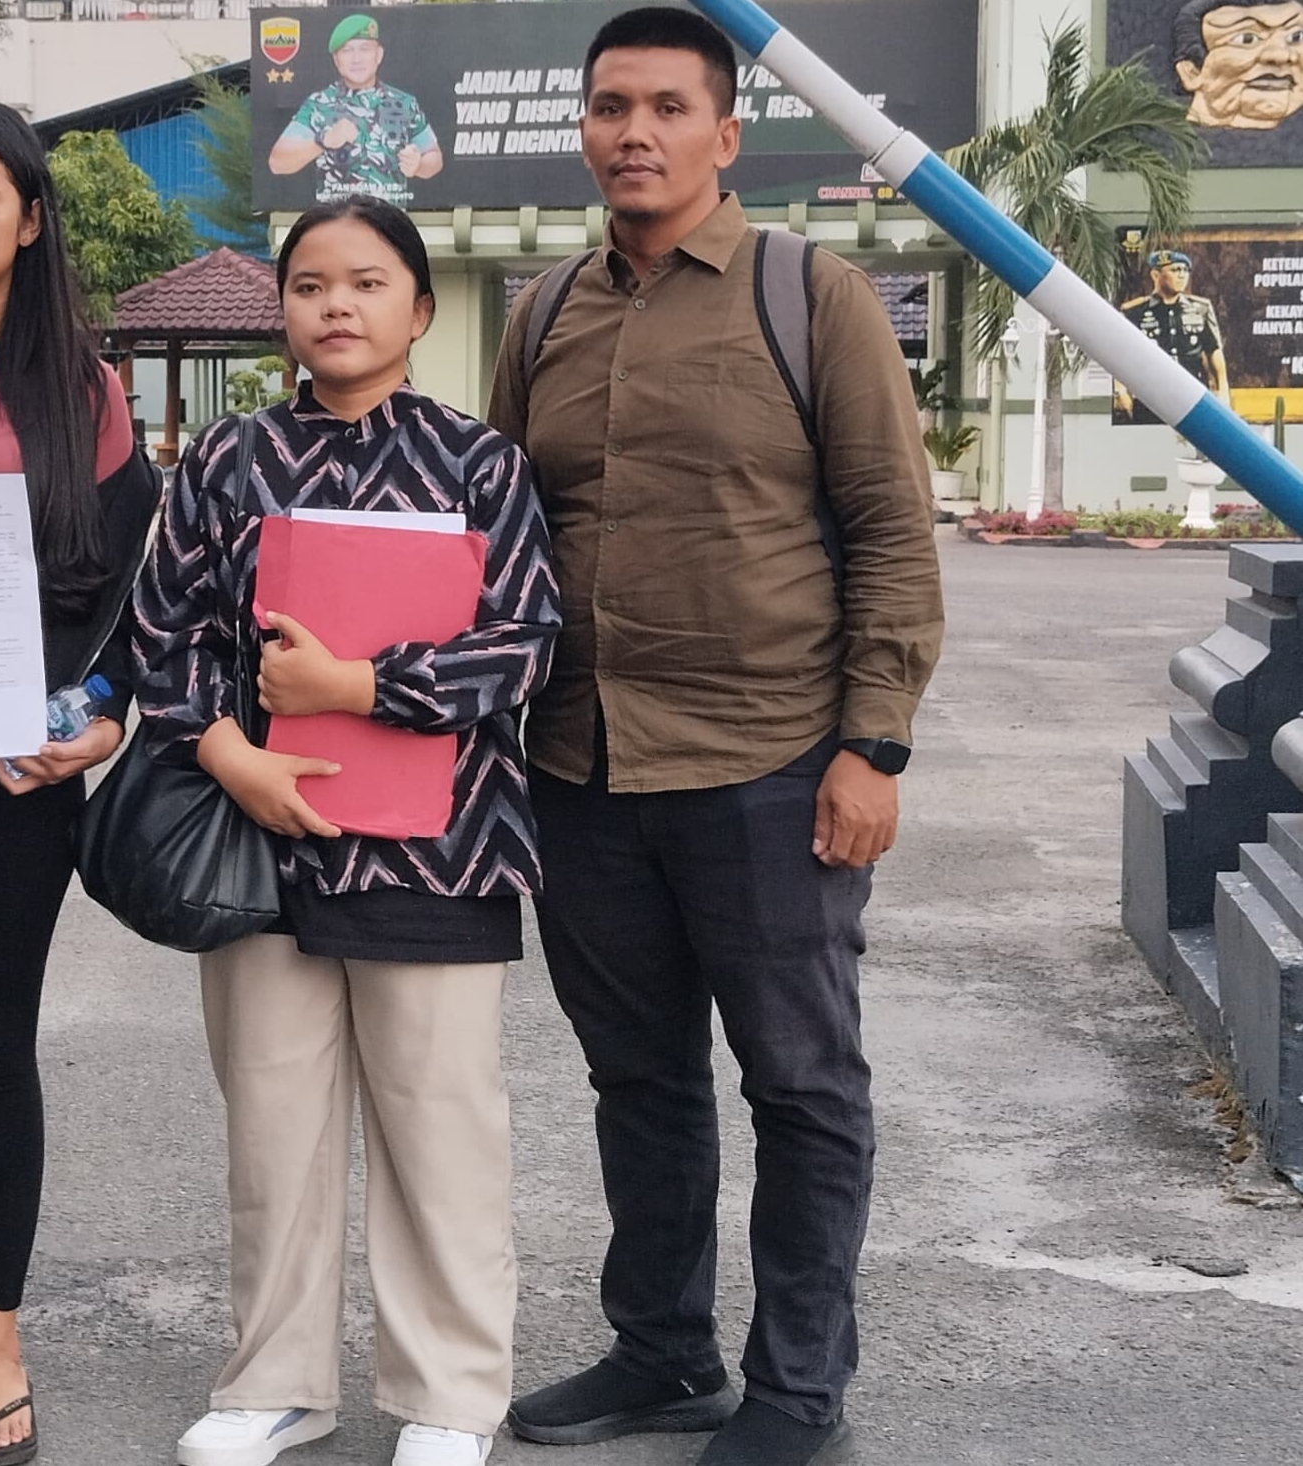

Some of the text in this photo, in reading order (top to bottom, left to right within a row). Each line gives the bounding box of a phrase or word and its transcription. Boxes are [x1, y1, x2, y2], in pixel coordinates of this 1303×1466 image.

[454, 69, 542, 95] JADILAH
[545, 68, 583, 92] PRA
[455, 101, 511, 125] YANG
[515, 98, 586, 124] DISIPL
[454, 129, 583, 155] DAN DICINTA
[1254, 273, 1303, 288] POPULA
[1265, 305, 1303, 319] KEKAY
[1252, 321, 1293, 335] HANYA
